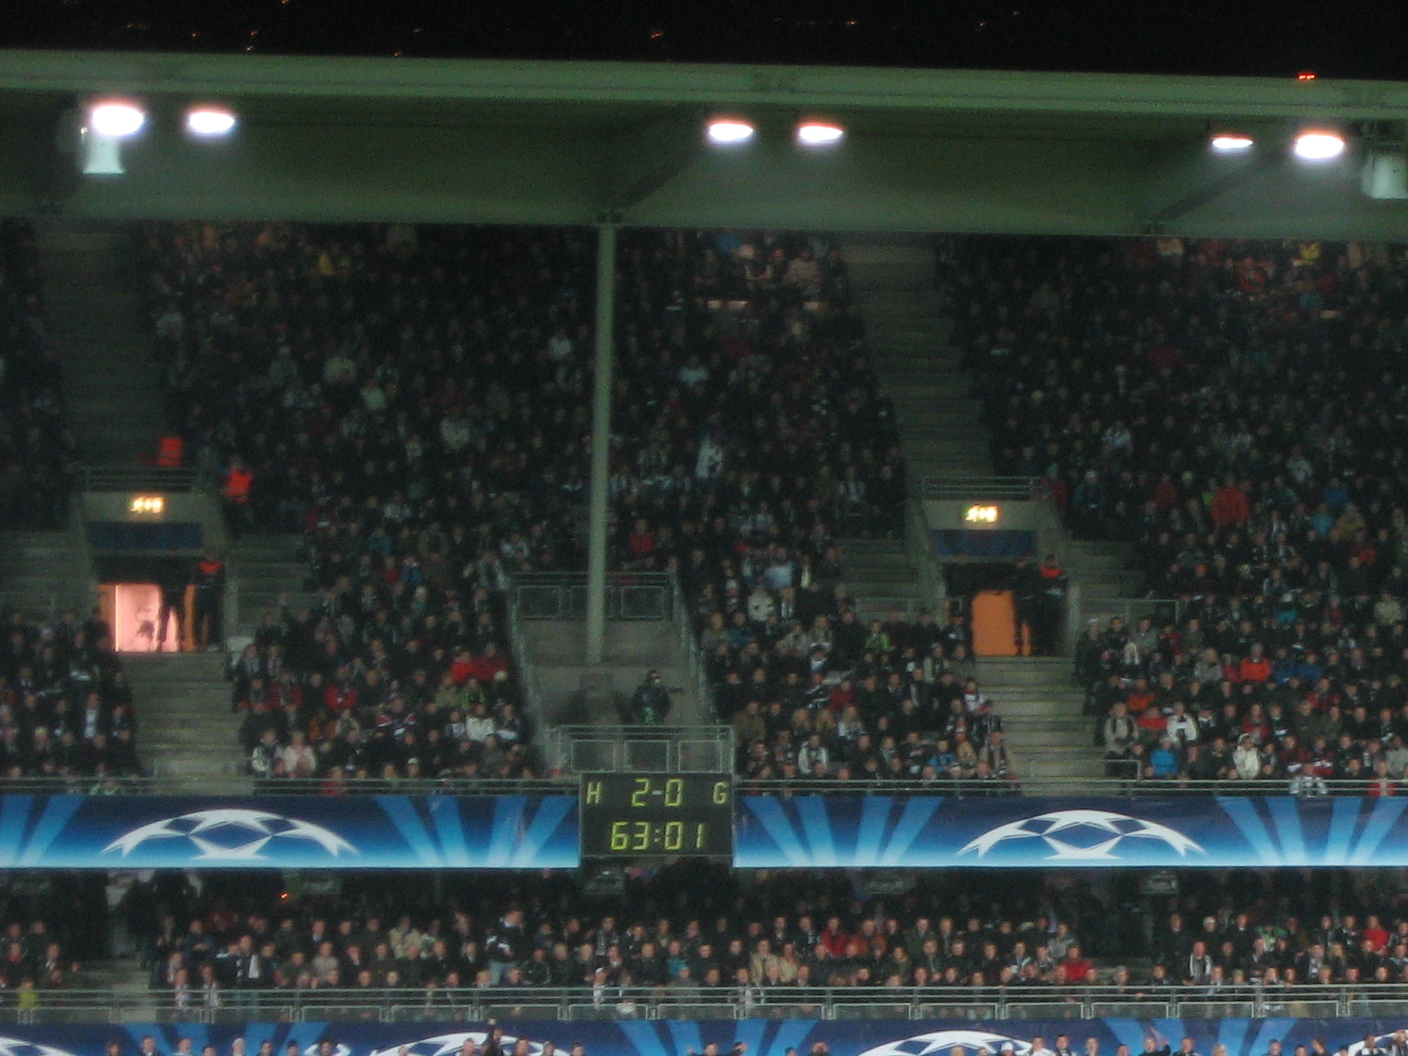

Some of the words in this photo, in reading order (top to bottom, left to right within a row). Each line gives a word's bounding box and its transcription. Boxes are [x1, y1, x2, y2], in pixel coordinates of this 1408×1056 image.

[586, 782, 601, 804] H
[631, 778, 684, 807] 2-0
[713, 781, 730, 805] G
[611, 821, 706, 850] 63:01
